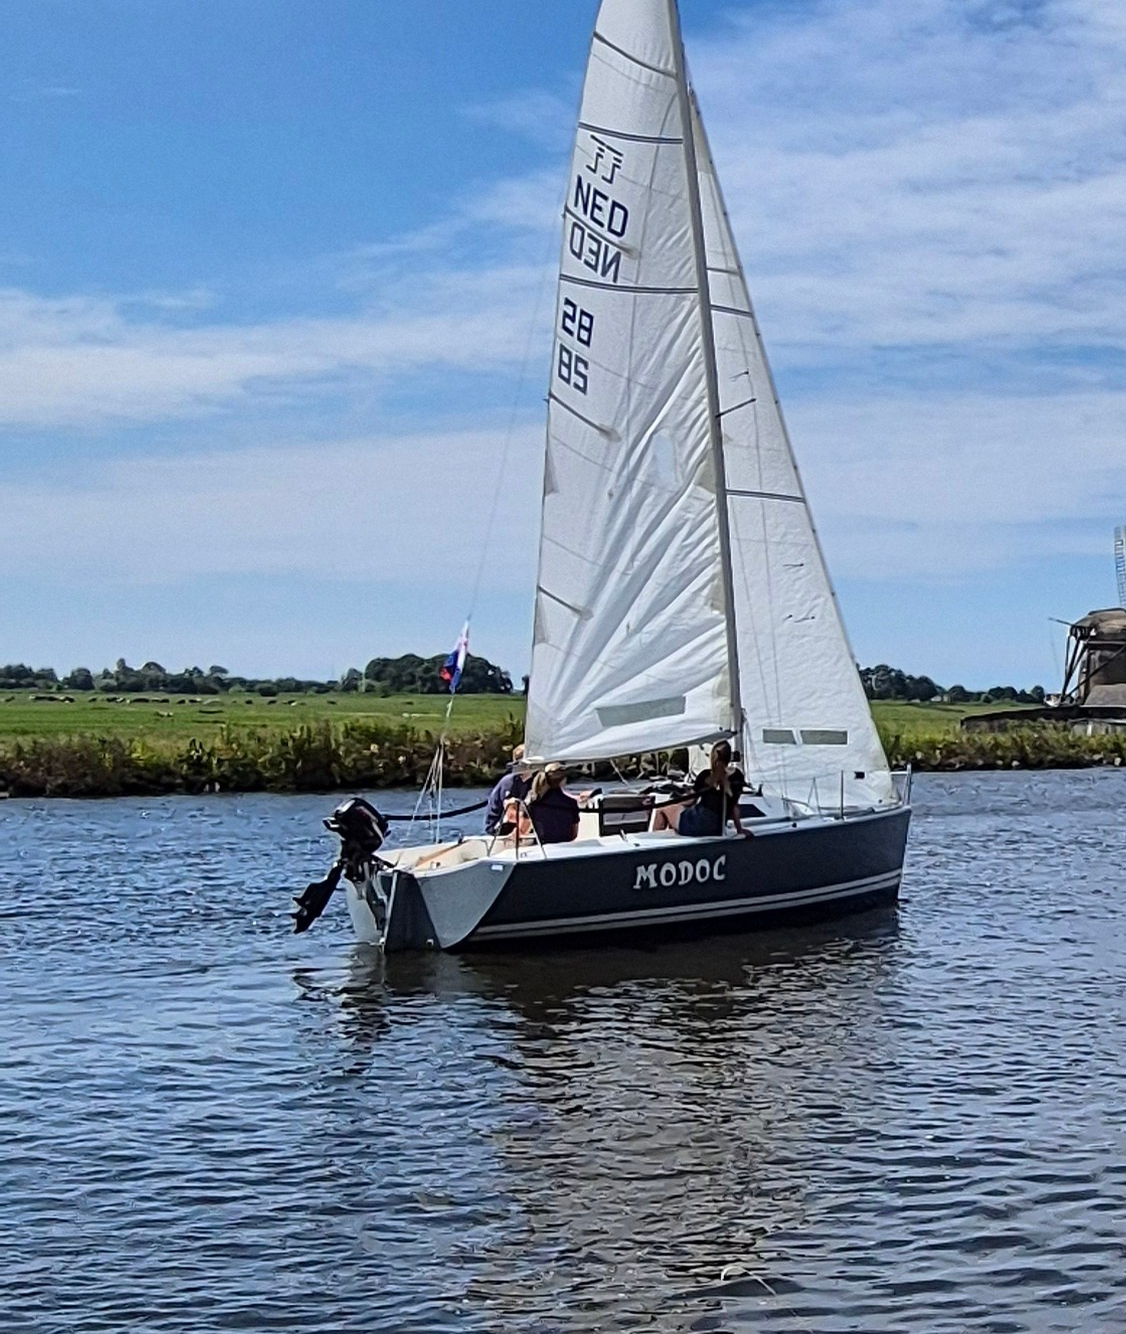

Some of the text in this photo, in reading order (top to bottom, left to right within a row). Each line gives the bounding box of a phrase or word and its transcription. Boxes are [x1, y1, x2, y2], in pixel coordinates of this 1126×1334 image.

[573, 174, 629, 237] NED
[561, 296, 595, 348] 28
[633, 854, 727, 889] MODOC
